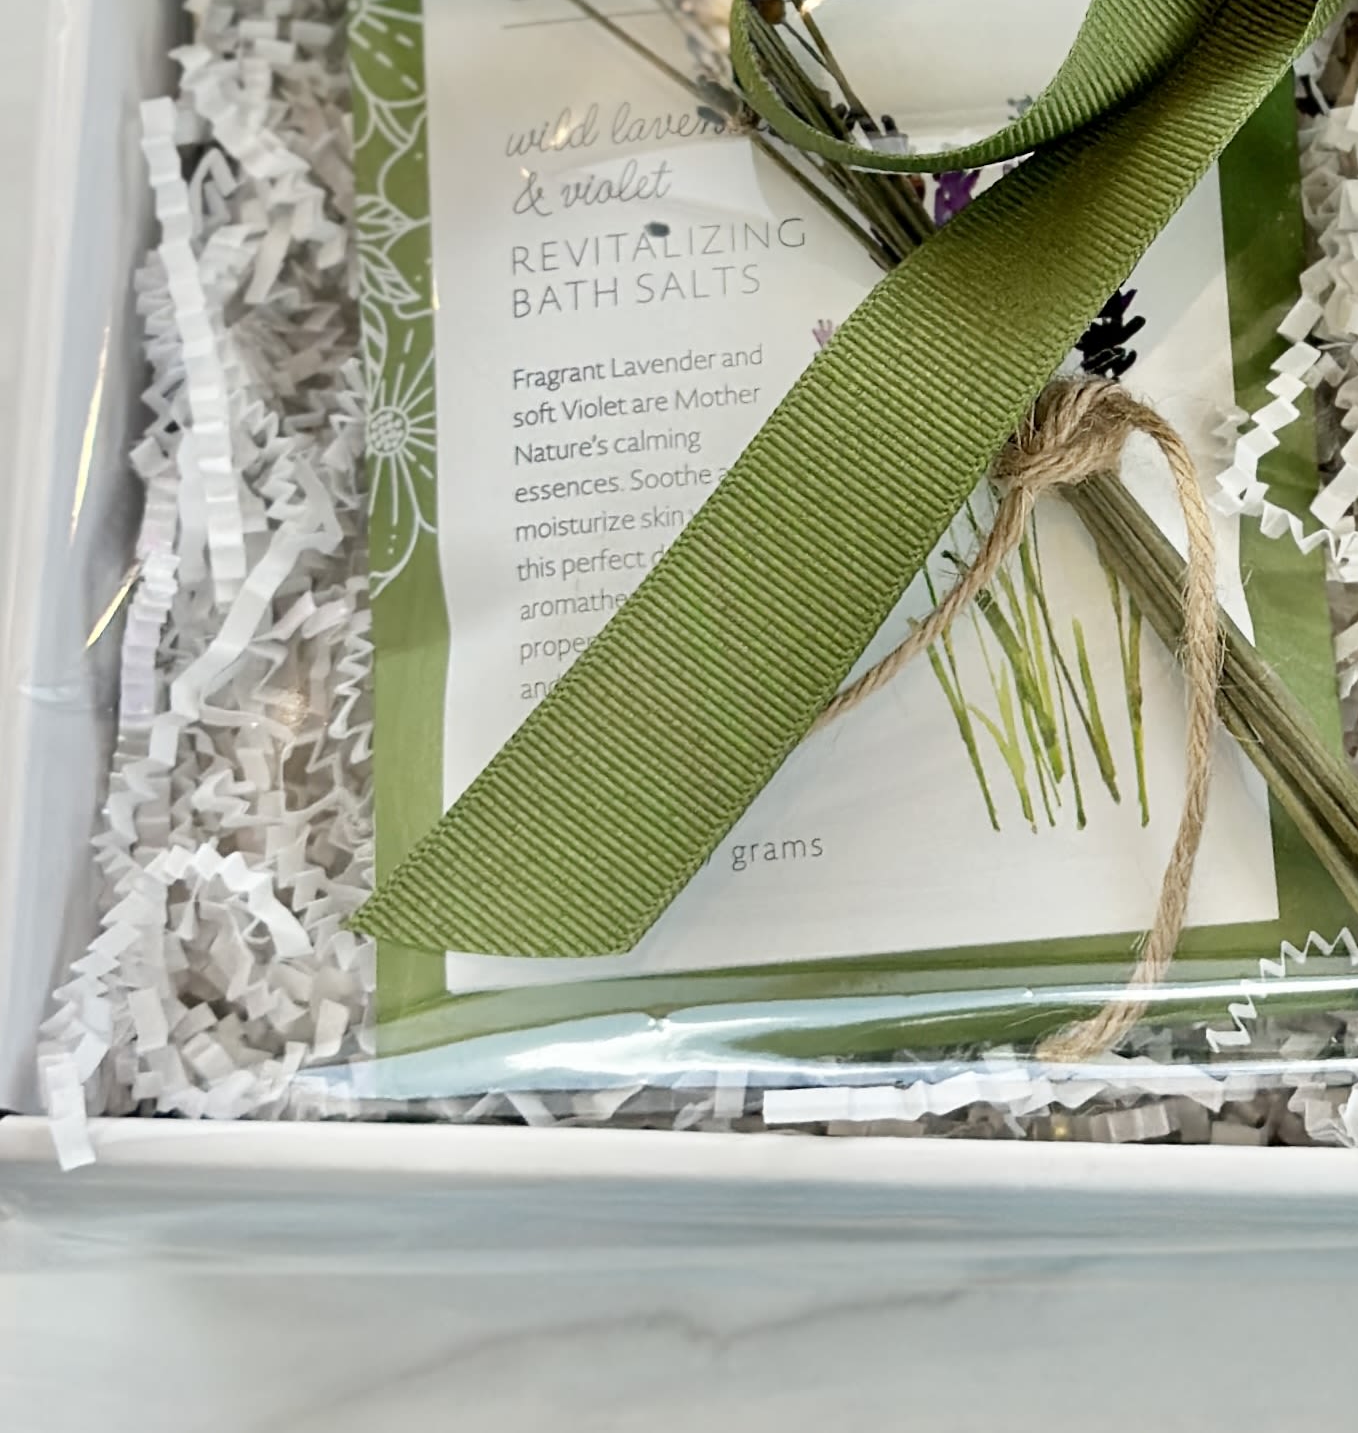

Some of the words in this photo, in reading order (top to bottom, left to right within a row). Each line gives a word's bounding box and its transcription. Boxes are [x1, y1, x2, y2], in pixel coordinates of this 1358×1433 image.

[506, 104, 597, 158] wild
[512, 166, 553, 217] &
[561, 159, 674, 209] violet
[512, 217, 806, 276] REVITALIZING
[512, 278, 618, 319] BATH
[636, 264, 760, 304] SALTS
[512, 361, 606, 391] Fragrant
[611, 349, 717, 379] Lavender
[722, 344, 763, 368] and
[512, 404, 557, 428] soft
[561, 395, 626, 421] Violet
[633, 396, 668, 415] are
[675, 385, 760, 411] Mother
[514, 435, 608, 465] Nature's
[614, 429, 702, 454] calming
[514, 475, 625, 503] essences.
[631, 464, 712, 492] Soothe
[515, 511, 635, 543] moisturize
[641, 504, 684, 528] skin
[518, 557, 556, 582] this
[562, 549, 644, 581] perfect
[520, 588, 629, 621] aromathe
[731, 835, 824, 871] grams
